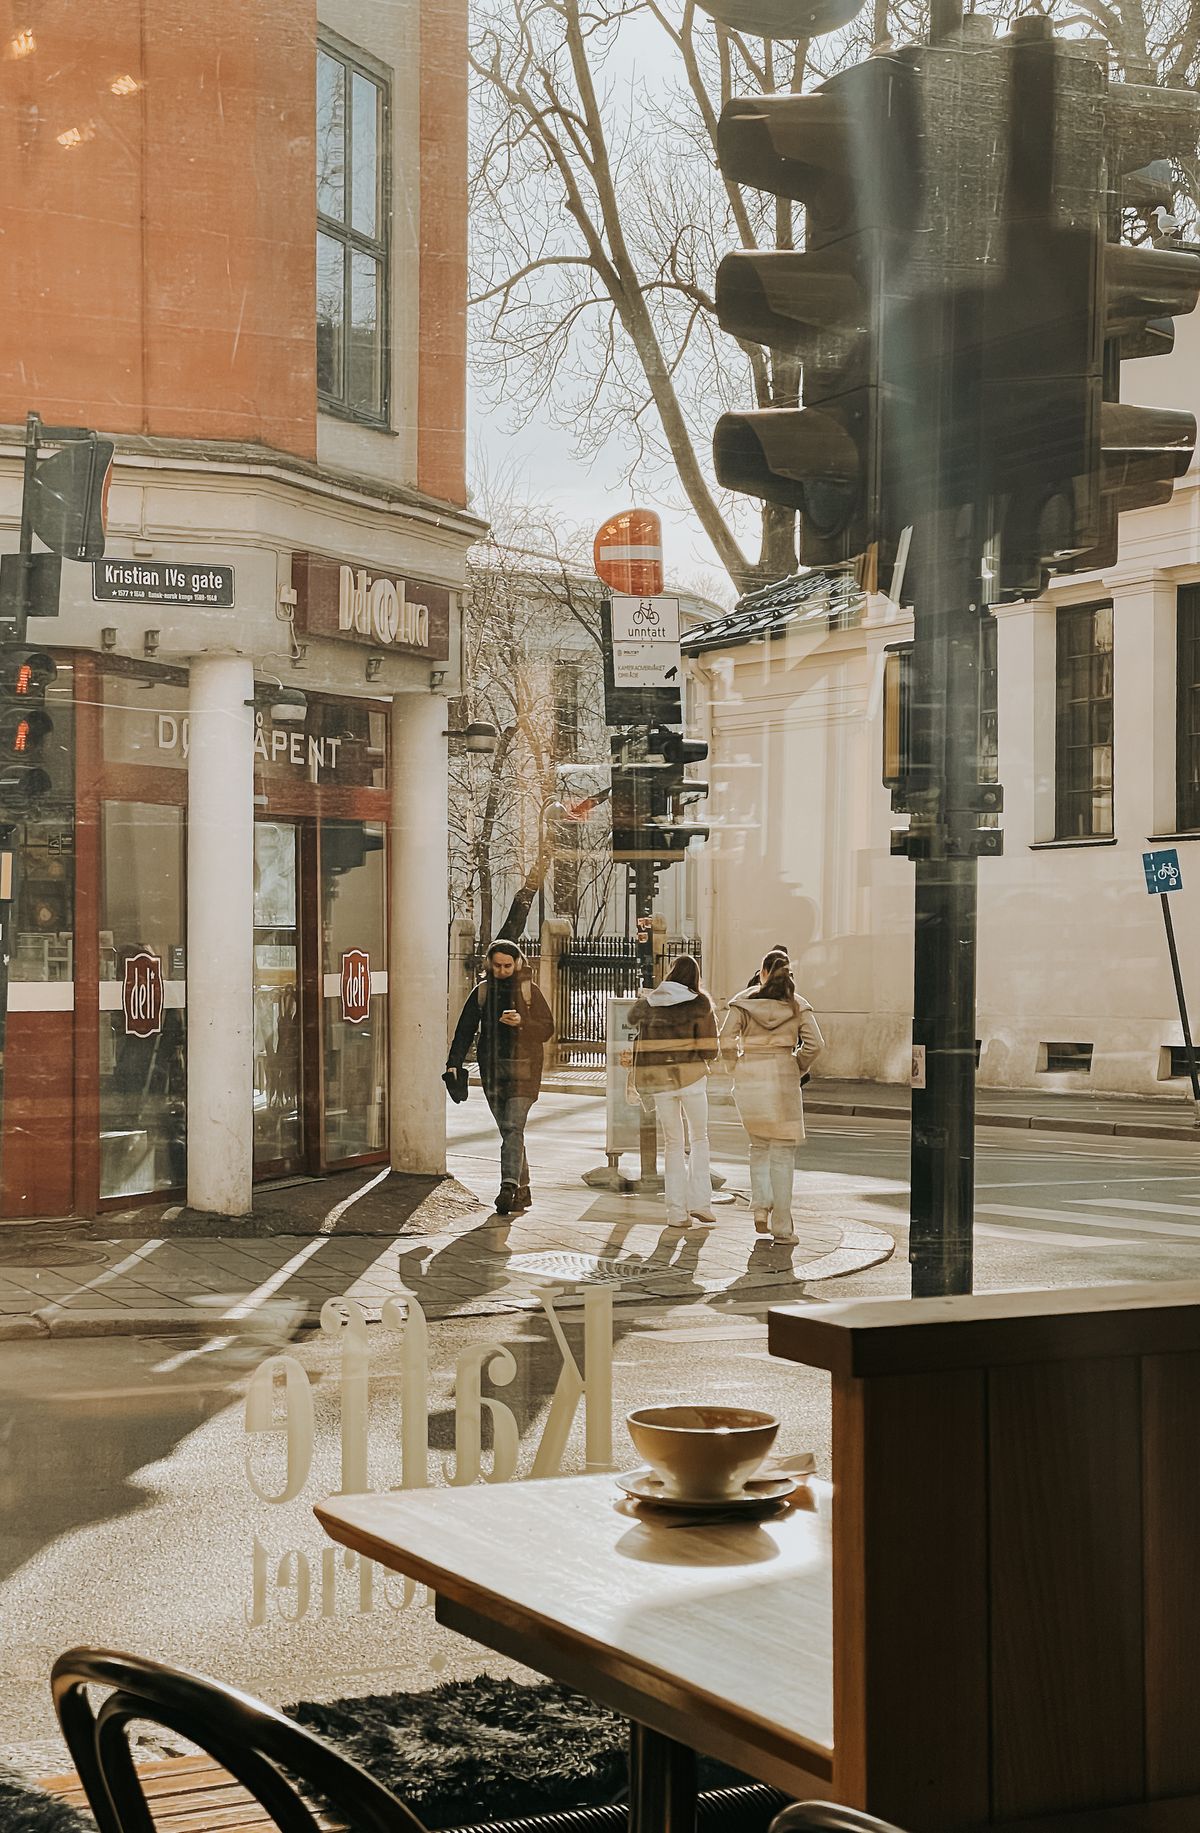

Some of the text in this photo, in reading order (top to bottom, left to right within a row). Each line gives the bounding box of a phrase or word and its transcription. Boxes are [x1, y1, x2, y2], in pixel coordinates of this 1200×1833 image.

[105, 564, 223, 593] Kristian IVs gate
[628, 627, 666, 638] unntatt
[130, 967, 156, 1020] deli
[346, 961, 365, 1008] deli
